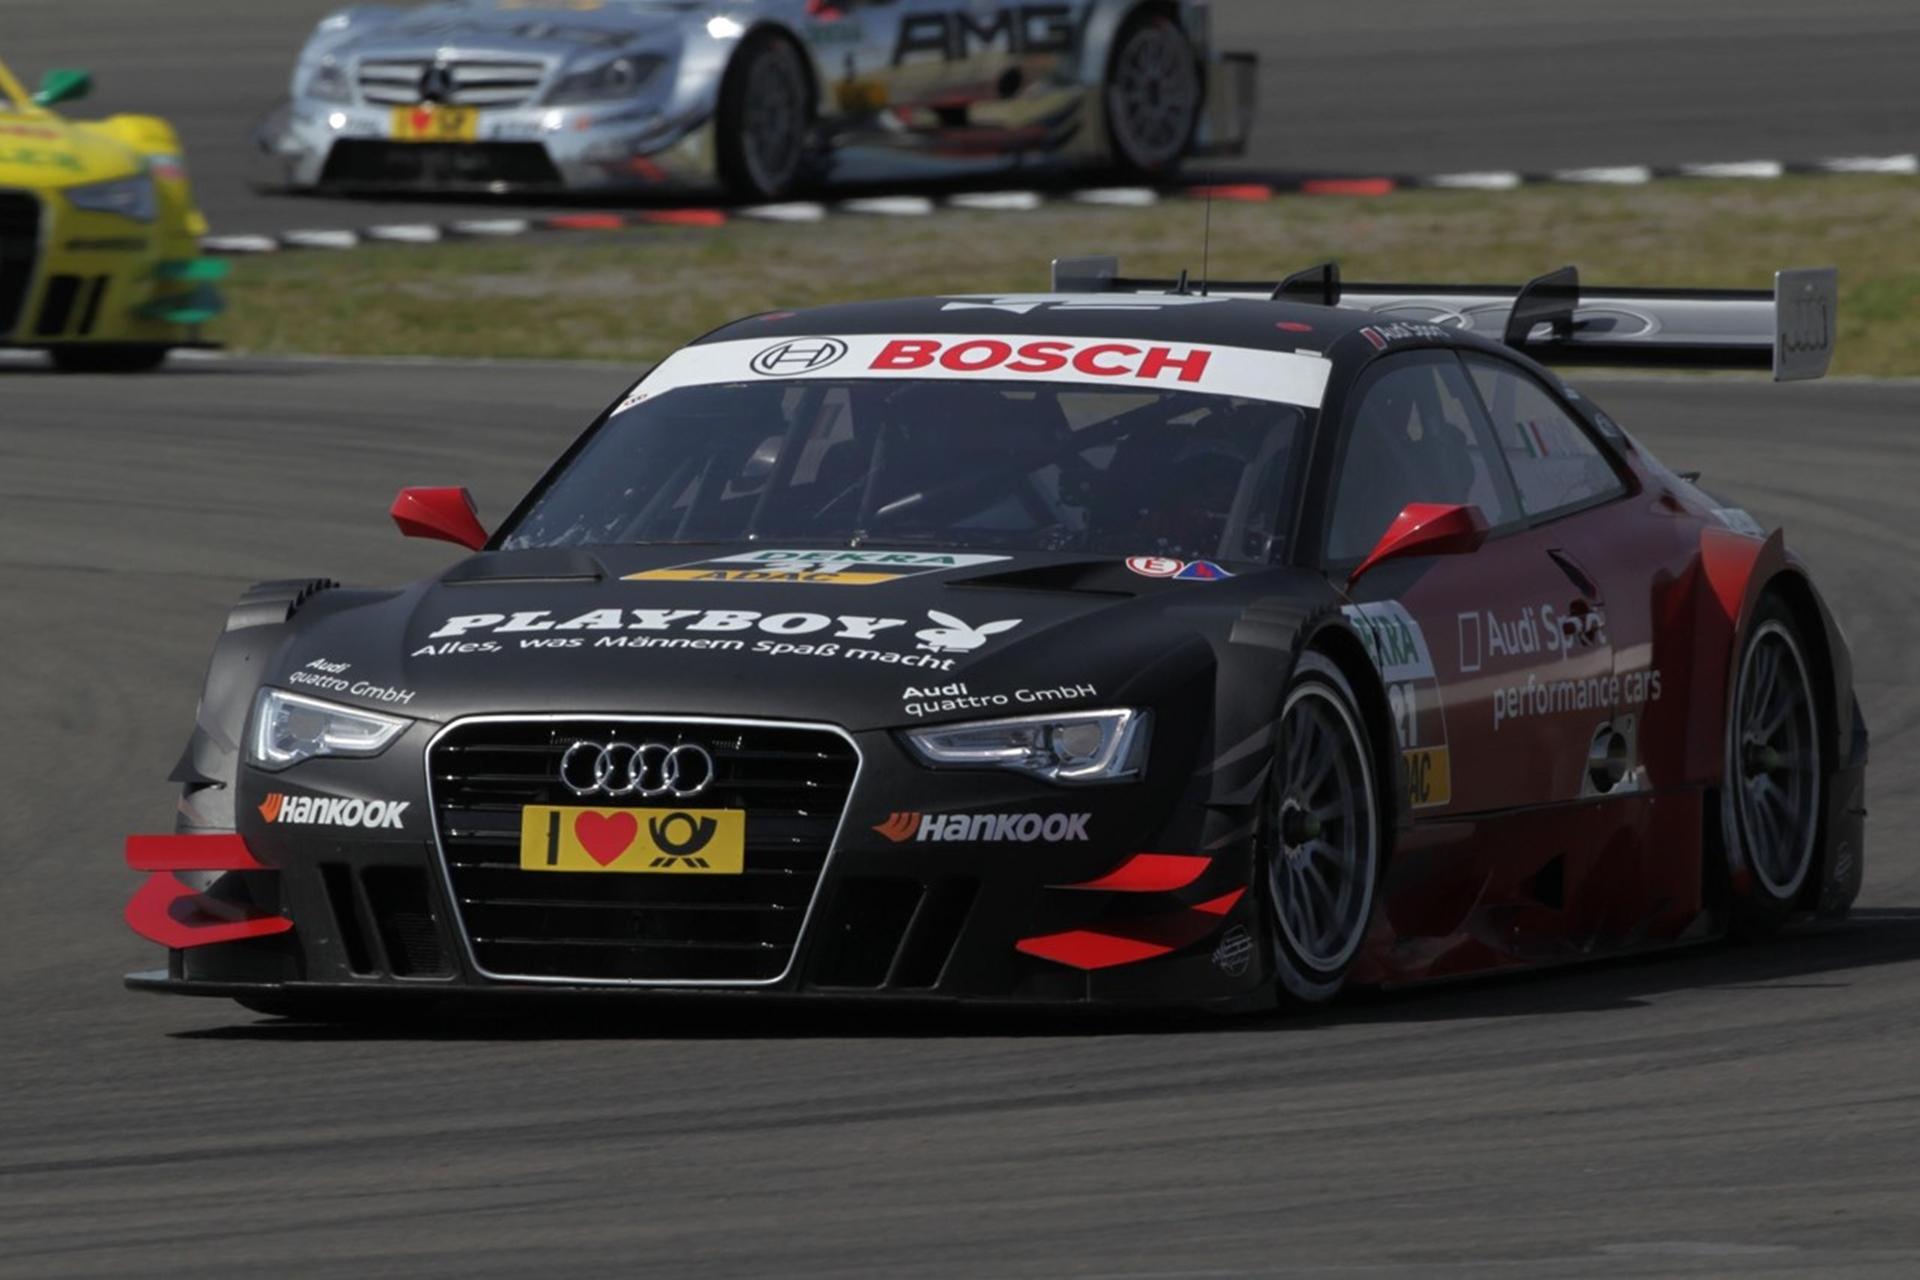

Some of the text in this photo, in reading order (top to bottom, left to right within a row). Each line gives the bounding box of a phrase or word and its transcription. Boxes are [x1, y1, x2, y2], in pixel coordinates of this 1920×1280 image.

[891, 5, 1073, 67] AMG
[869, 340, 1211, 382] BOSCH
[755, 552, 955, 565] DEKRA
[693, 571, 839, 581] ADAC
[428, 608, 907, 640] PLAYBOY
[1487, 606, 1541, 656] Audi
[305, 657, 352, 674] Audi
[411, 636, 957, 671] Alles, was Männern Spaß macht
[289, 671, 416, 705] quattro GmbH
[902, 682, 968, 700] Audi
[904, 683, 1098, 717] quattro GmbH
[1494, 669, 1663, 731] performance cars
